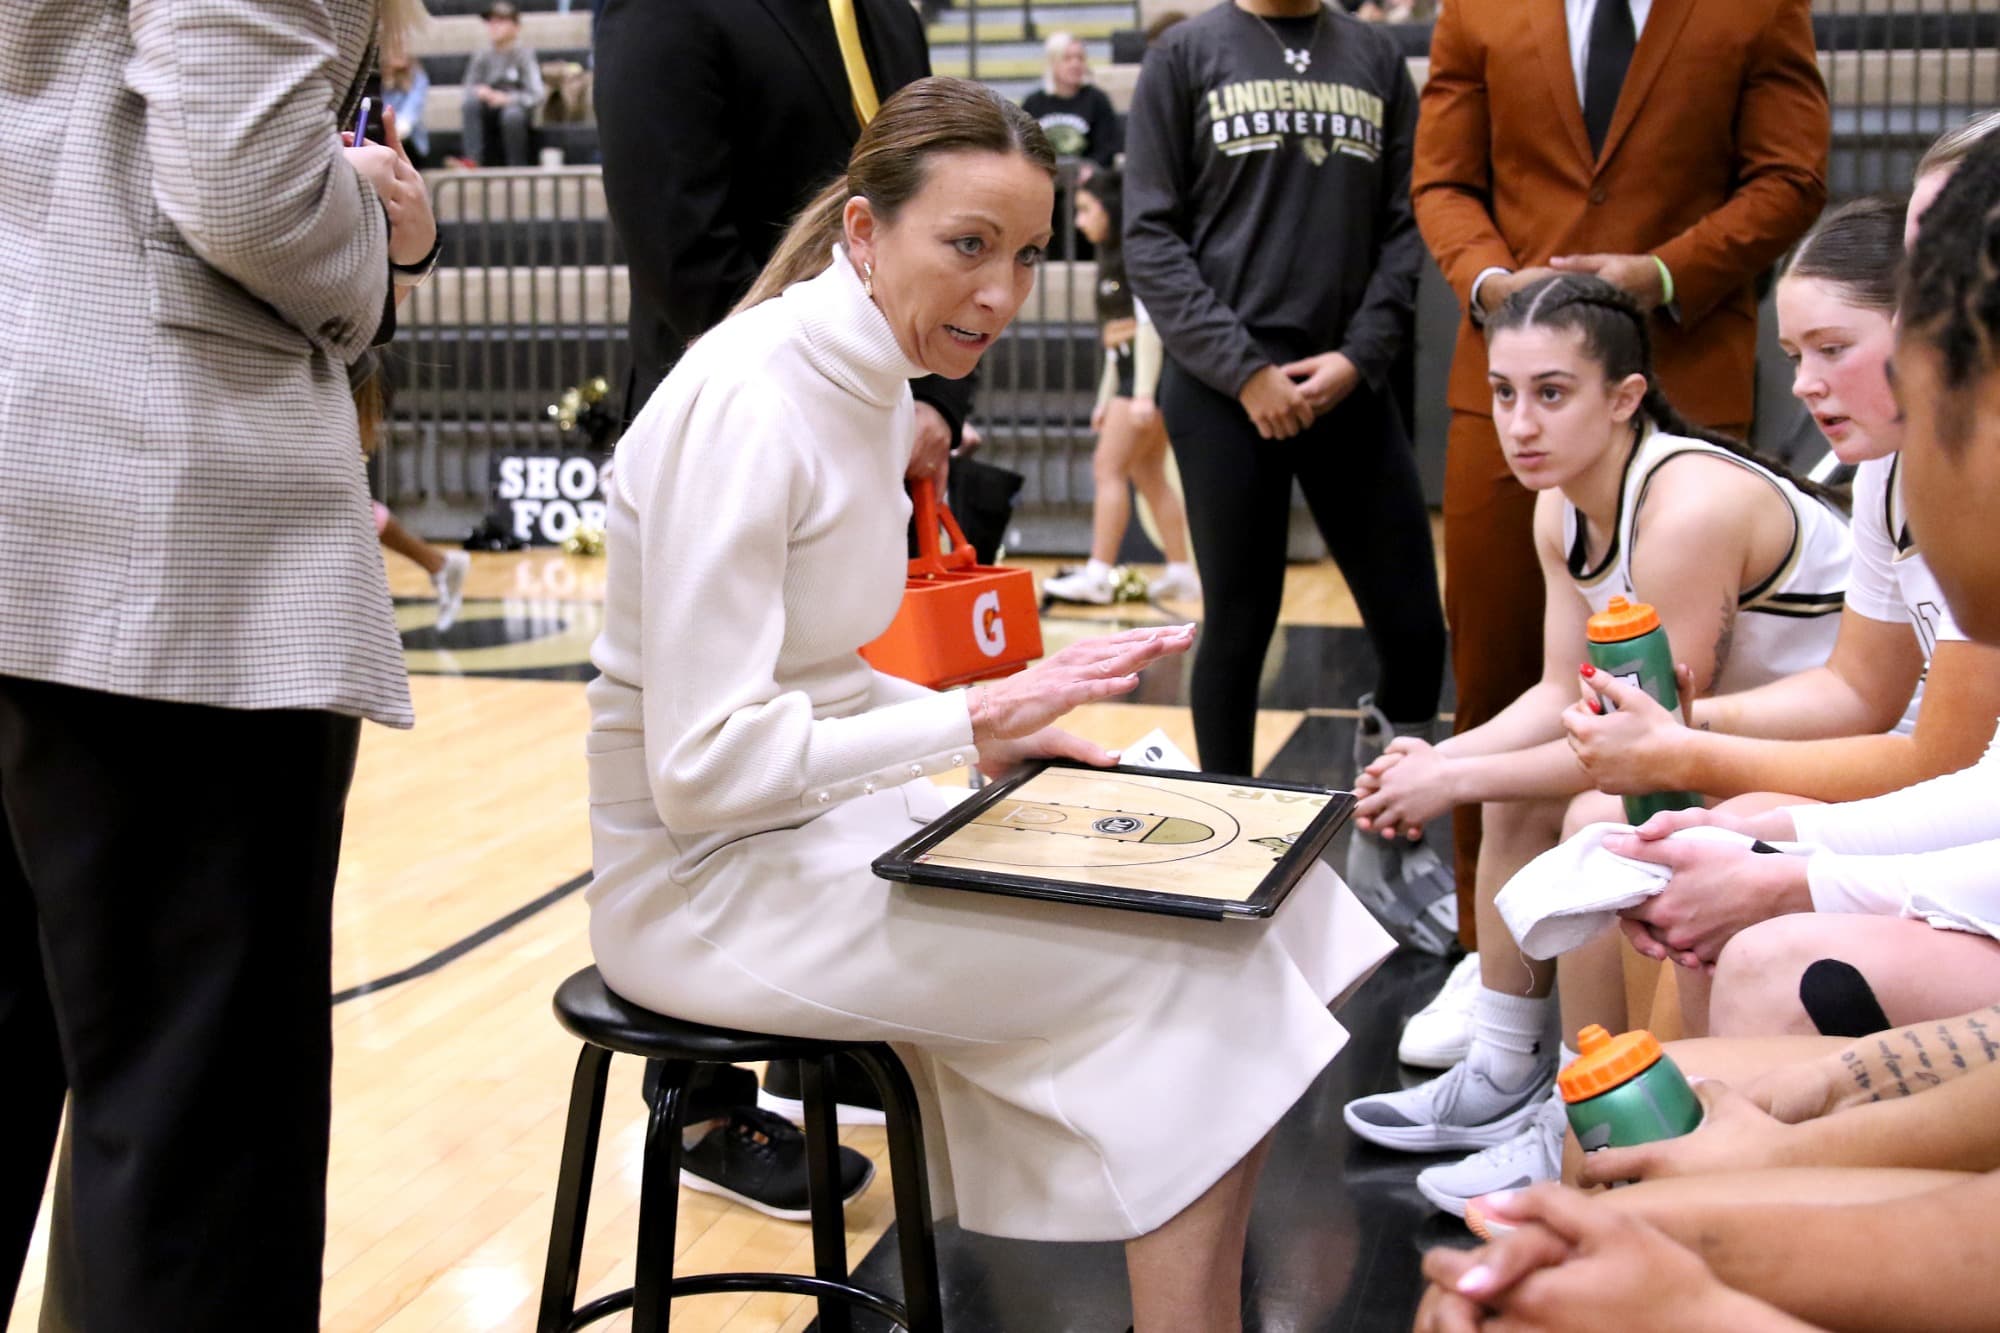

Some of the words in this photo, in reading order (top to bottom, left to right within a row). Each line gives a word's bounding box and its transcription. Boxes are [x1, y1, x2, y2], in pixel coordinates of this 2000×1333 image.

[1207, 79, 1384, 129] LINDENWOOD
[1212, 110, 1383, 151] BASKETBALL
[972, 590, 1007, 658] G
